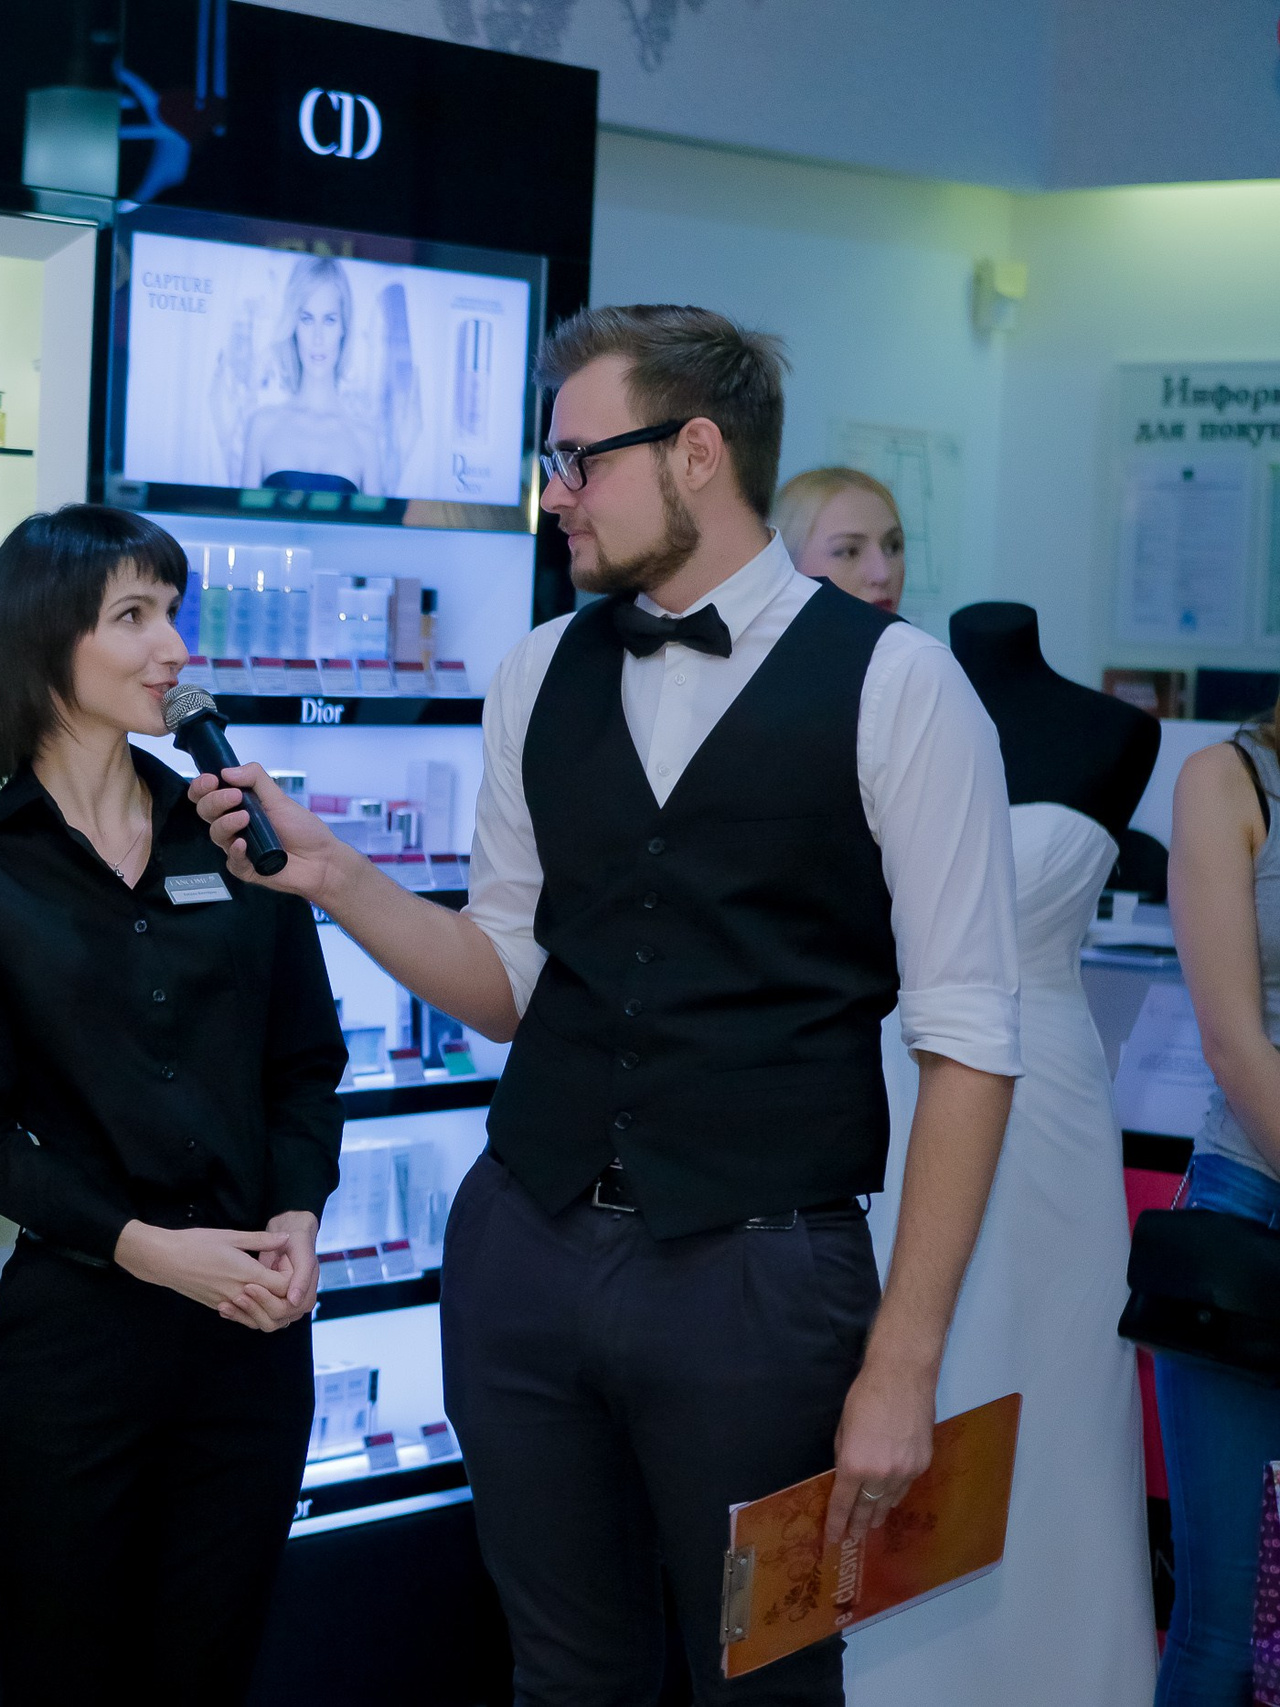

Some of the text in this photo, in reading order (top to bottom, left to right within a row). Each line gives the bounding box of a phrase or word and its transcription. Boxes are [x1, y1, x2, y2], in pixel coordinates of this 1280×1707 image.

[142, 271, 214, 294] CAPTURE
[148, 292, 207, 314] TOTALE
[1134, 422, 1185, 444] для
[300, 697, 345, 724] Dior
